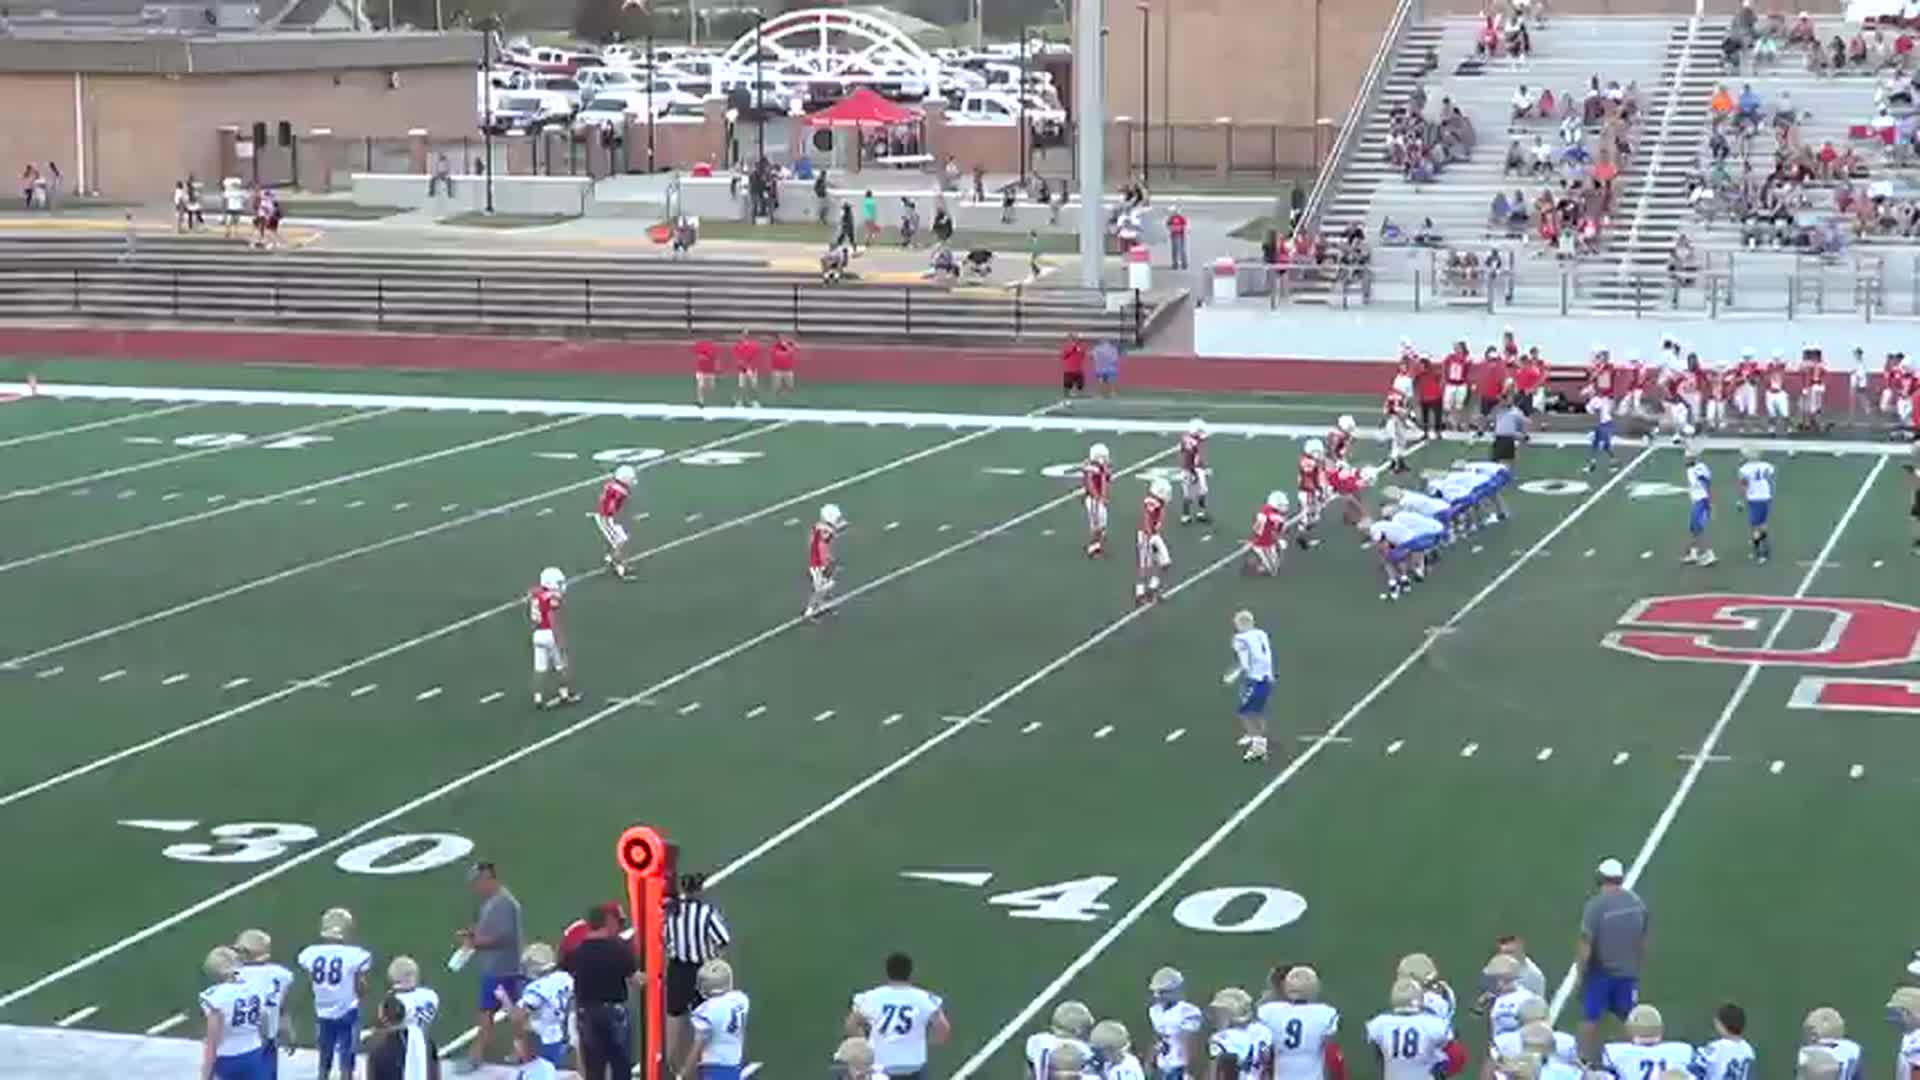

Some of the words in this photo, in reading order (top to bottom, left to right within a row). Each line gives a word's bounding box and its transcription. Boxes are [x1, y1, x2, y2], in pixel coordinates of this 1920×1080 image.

[312, 955, 344, 985] 88
[878, 1003, 914, 1035] 75
[1284, 1017, 1303, 1050] 9
[1391, 1026, 1420, 1059] 18
